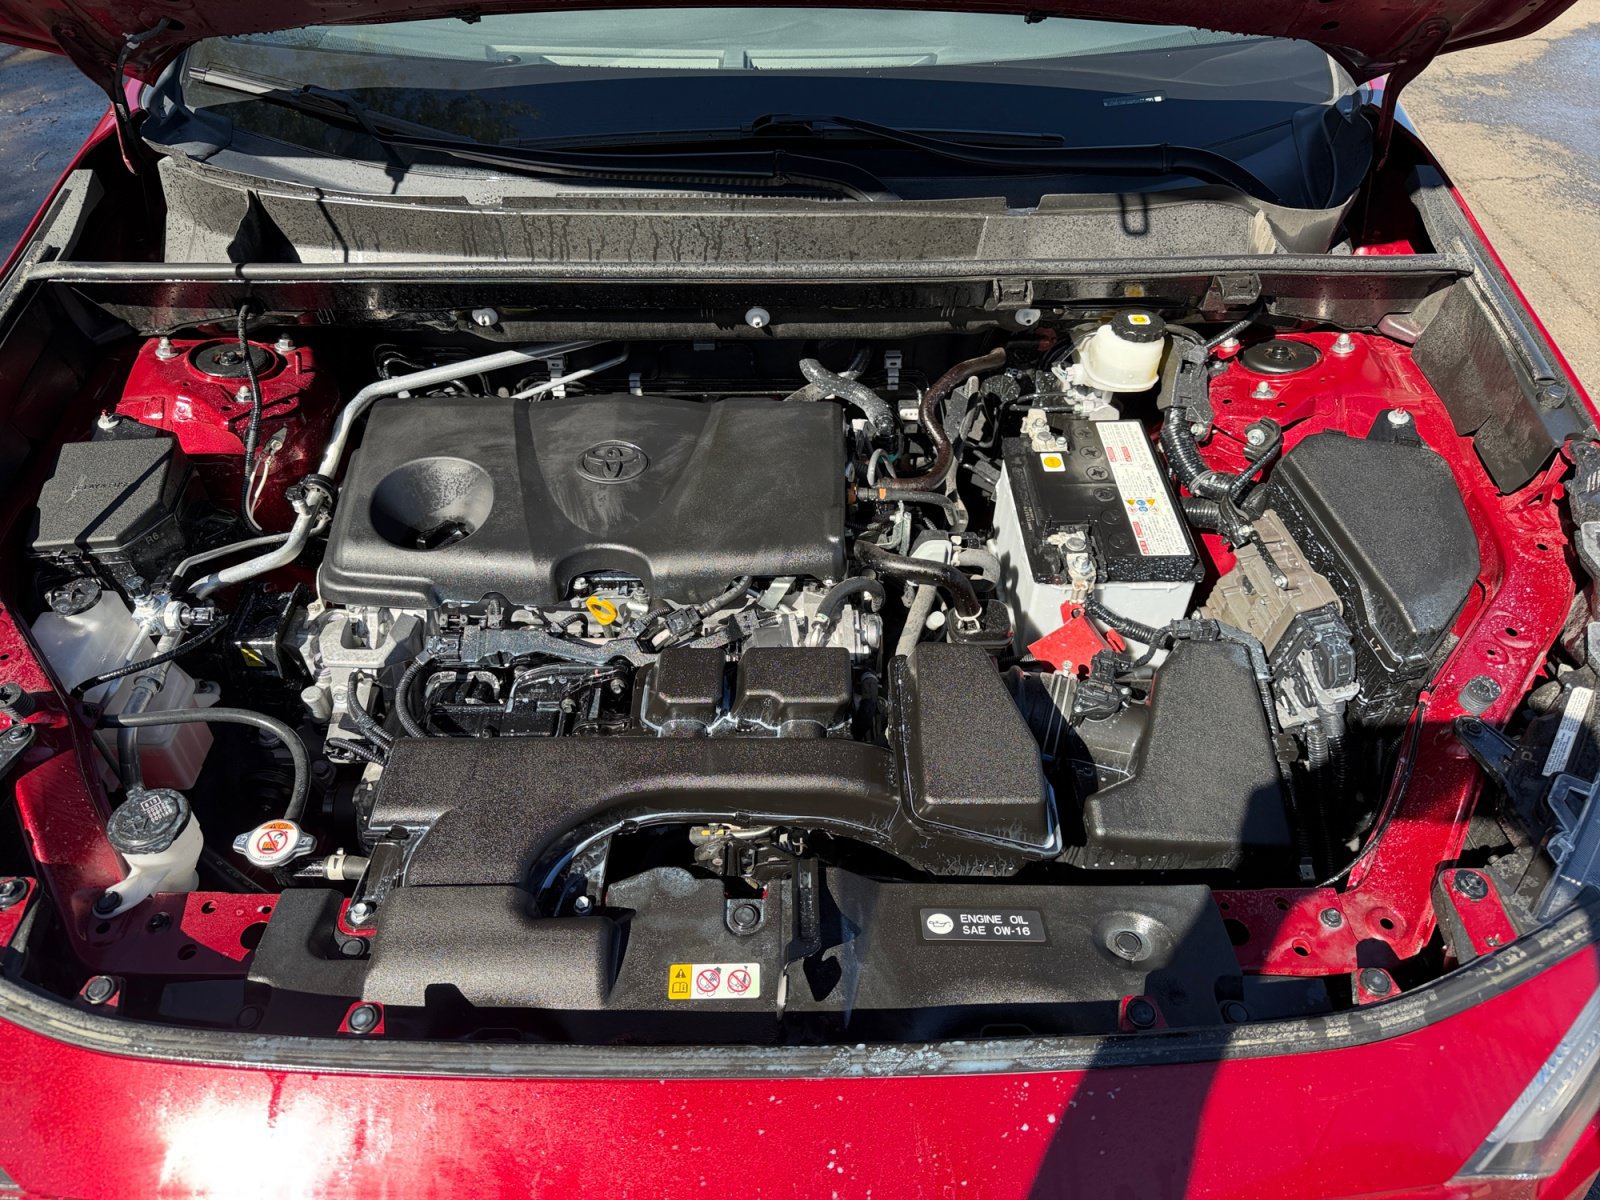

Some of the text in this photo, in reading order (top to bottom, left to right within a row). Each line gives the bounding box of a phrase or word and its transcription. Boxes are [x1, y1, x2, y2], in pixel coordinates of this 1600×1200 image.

[144, 532, 159, 544] R6
[960, 914, 1028, 924] ENGINE OIL
[962, 926, 1030, 936] SAE 0W-16
